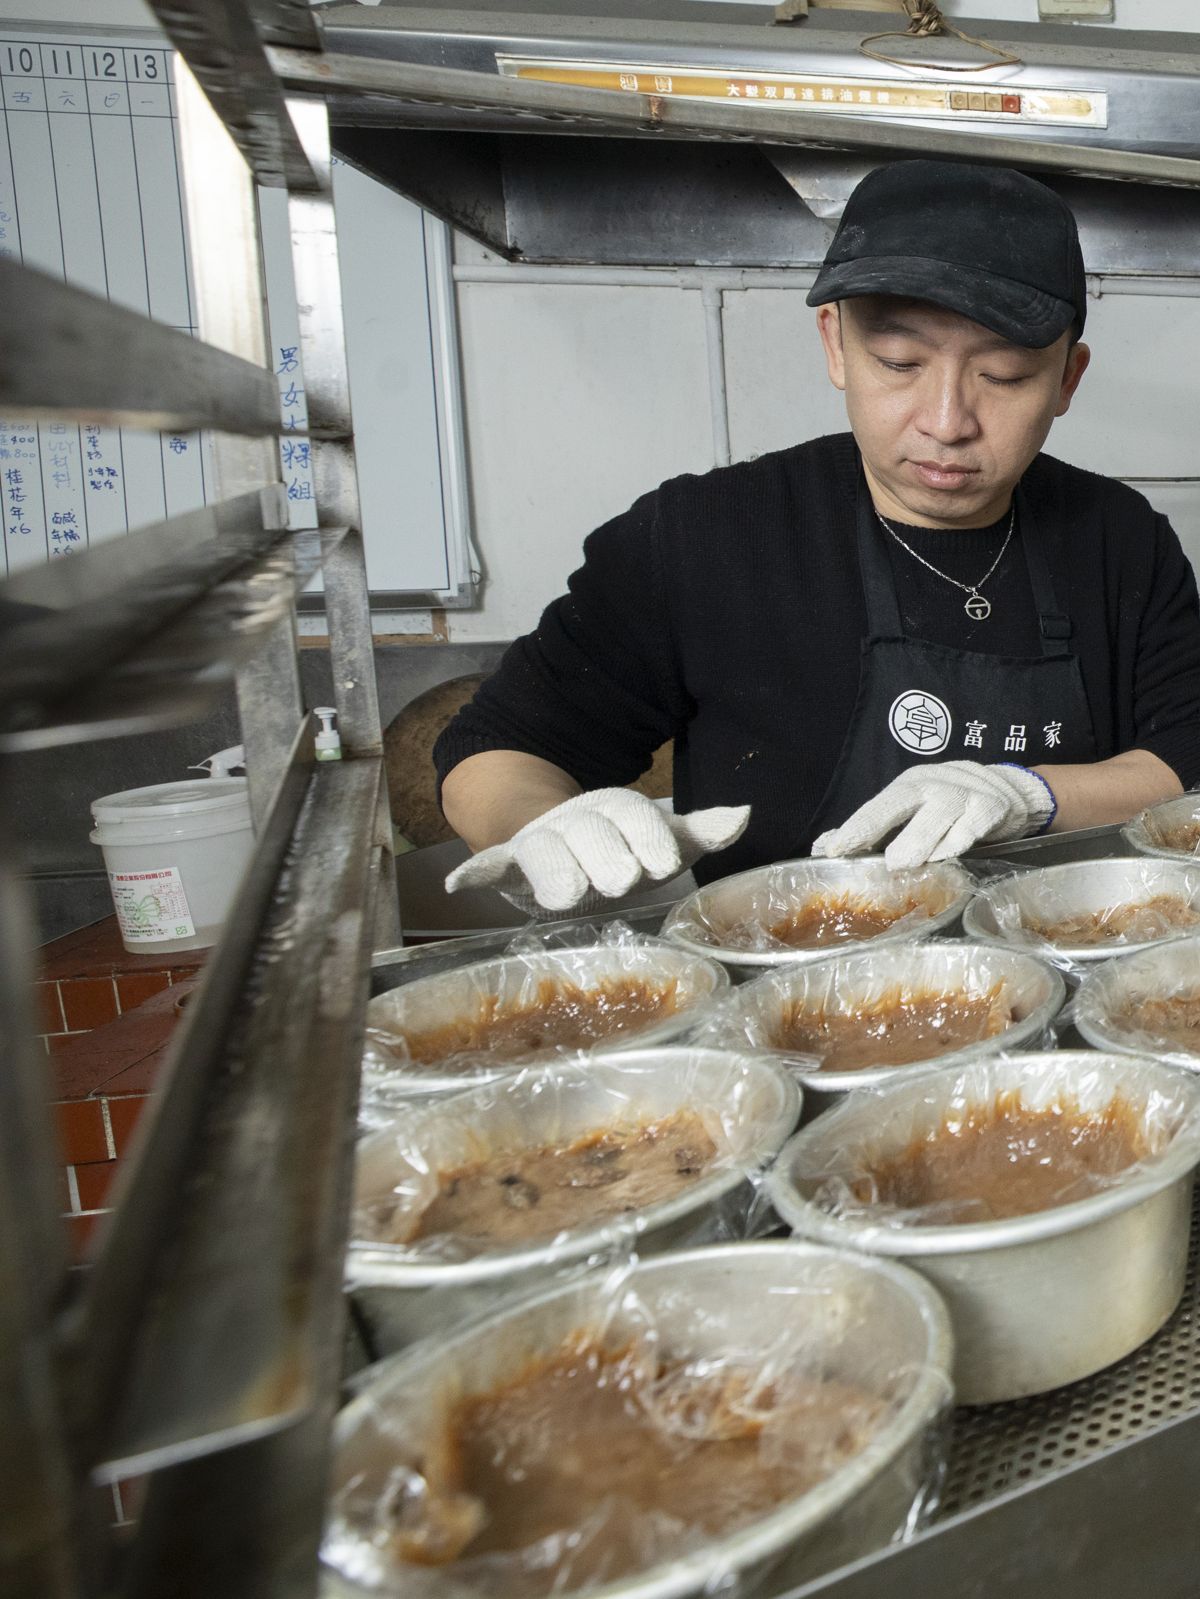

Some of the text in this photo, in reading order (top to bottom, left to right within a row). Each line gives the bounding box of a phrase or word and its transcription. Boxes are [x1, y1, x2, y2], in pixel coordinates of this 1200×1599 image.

[7, 47, 158, 79] 10 11 12 13
[58, 90, 76, 106] 六
[963, 719, 1063, 752] 富品家
